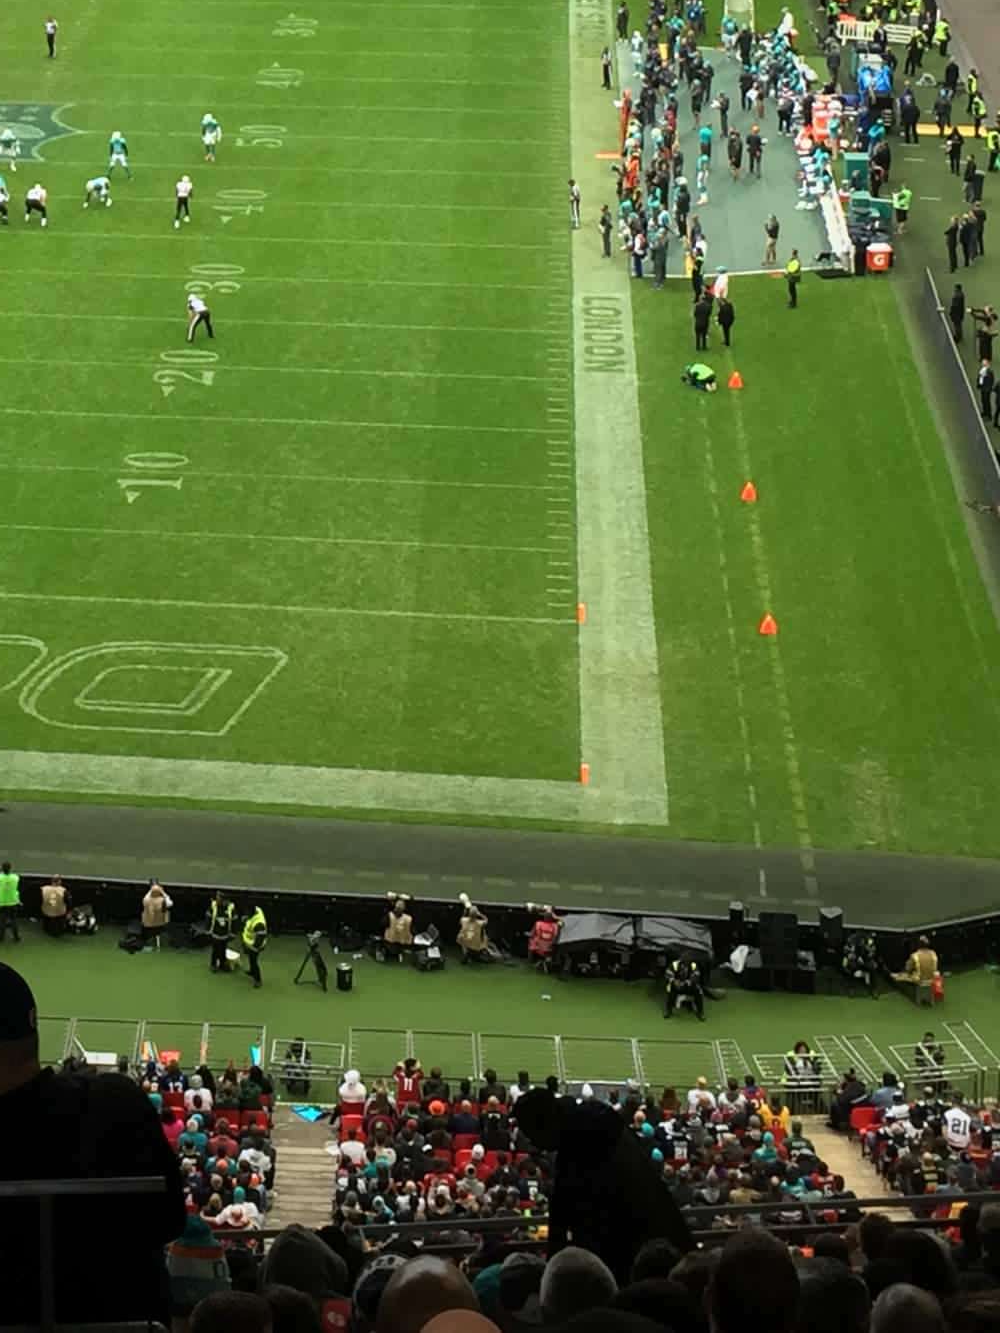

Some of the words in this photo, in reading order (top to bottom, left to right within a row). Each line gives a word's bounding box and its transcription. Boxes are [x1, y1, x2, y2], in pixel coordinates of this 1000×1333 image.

[211, 189, 267, 215] 40
[184, 263, 246, 296] 30
[582, 295, 625, 373] LONDON
[152, 349, 219, 386] 20
[116, 451, 189, 491] 10
[951, 1118, 968, 1135] 21
